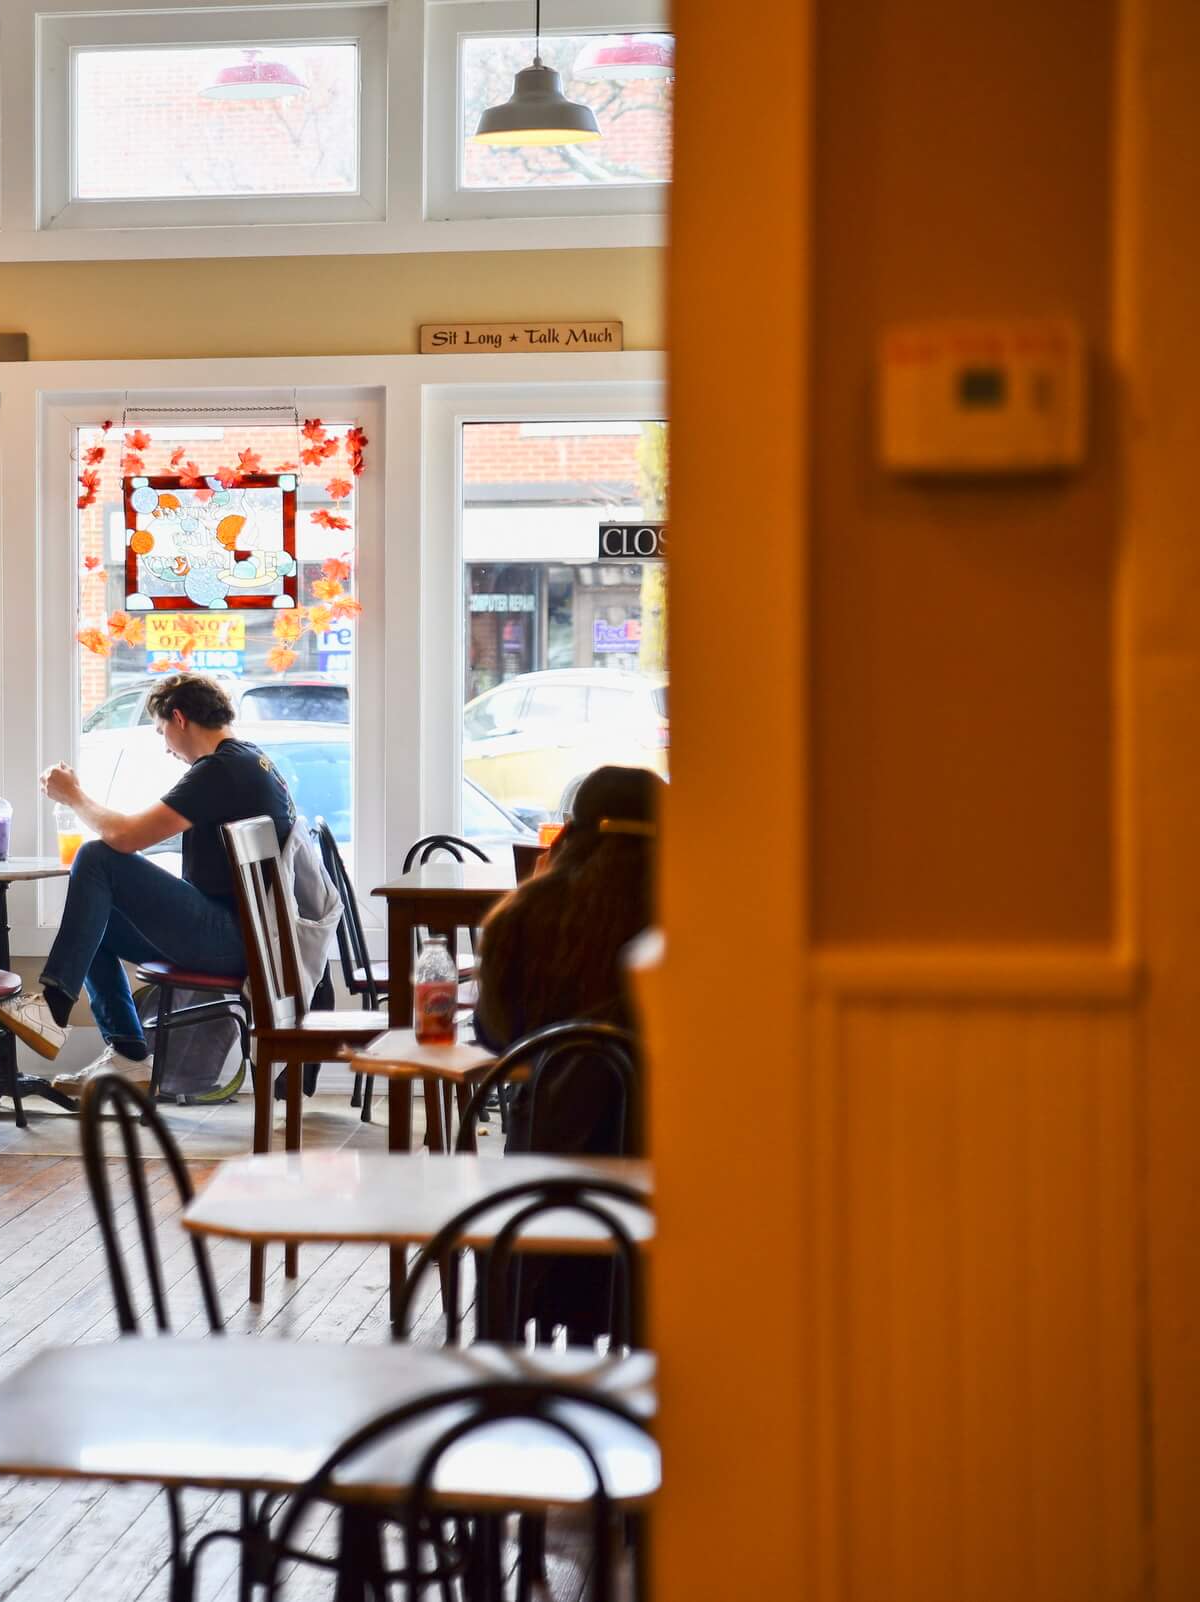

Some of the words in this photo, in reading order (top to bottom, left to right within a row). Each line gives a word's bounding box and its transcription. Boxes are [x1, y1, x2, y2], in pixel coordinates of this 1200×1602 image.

[431, 330, 457, 347] Sit
[464, 330, 502, 348] Long
[524, 328, 560, 344] Talk
[565, 327, 613, 345] Much
[160, 635, 232, 647] OFER
